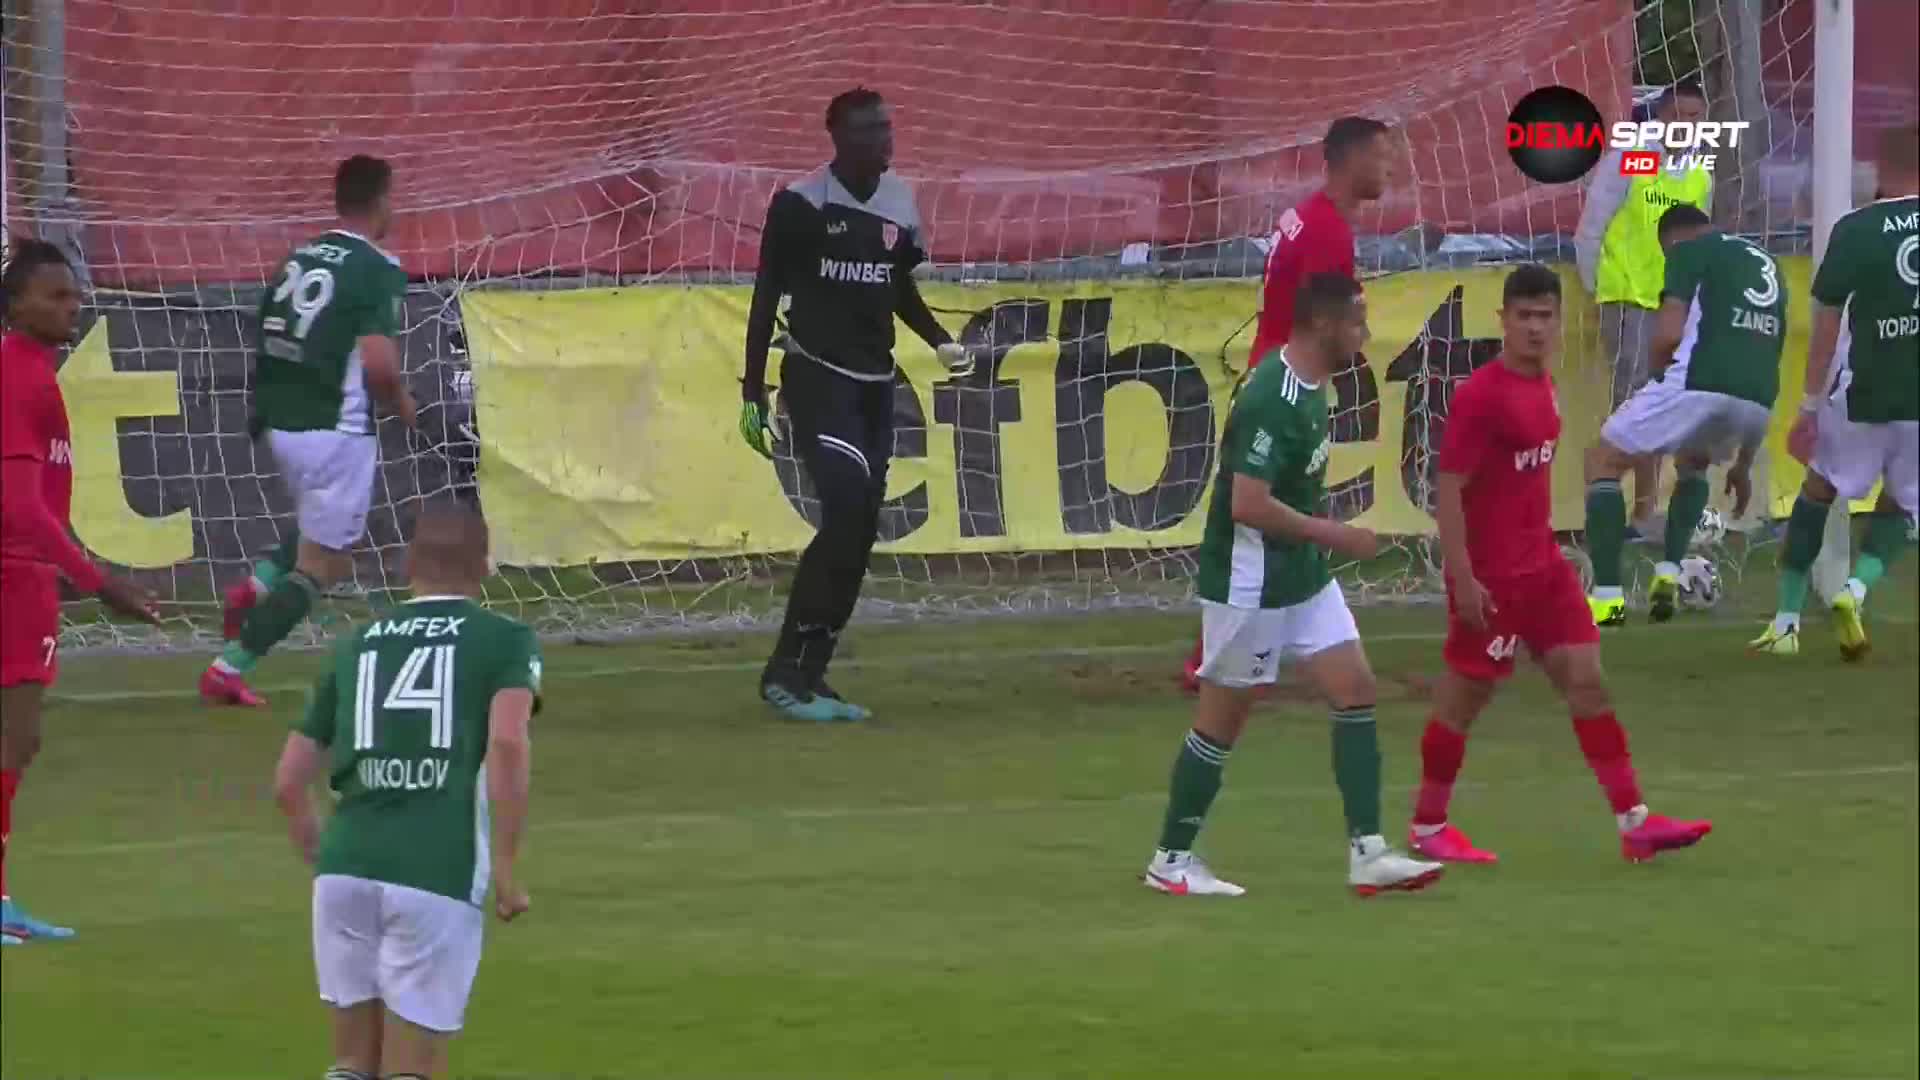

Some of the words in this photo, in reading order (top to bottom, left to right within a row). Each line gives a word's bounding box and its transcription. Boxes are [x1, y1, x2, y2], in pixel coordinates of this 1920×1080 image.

[820, 258, 896, 284] WINBET
[1743, 247, 1779, 308] 3
[363, 616, 467, 639] AMFEX
[42, 636, 56, 667] 7
[354, 645, 455, 750] 14
